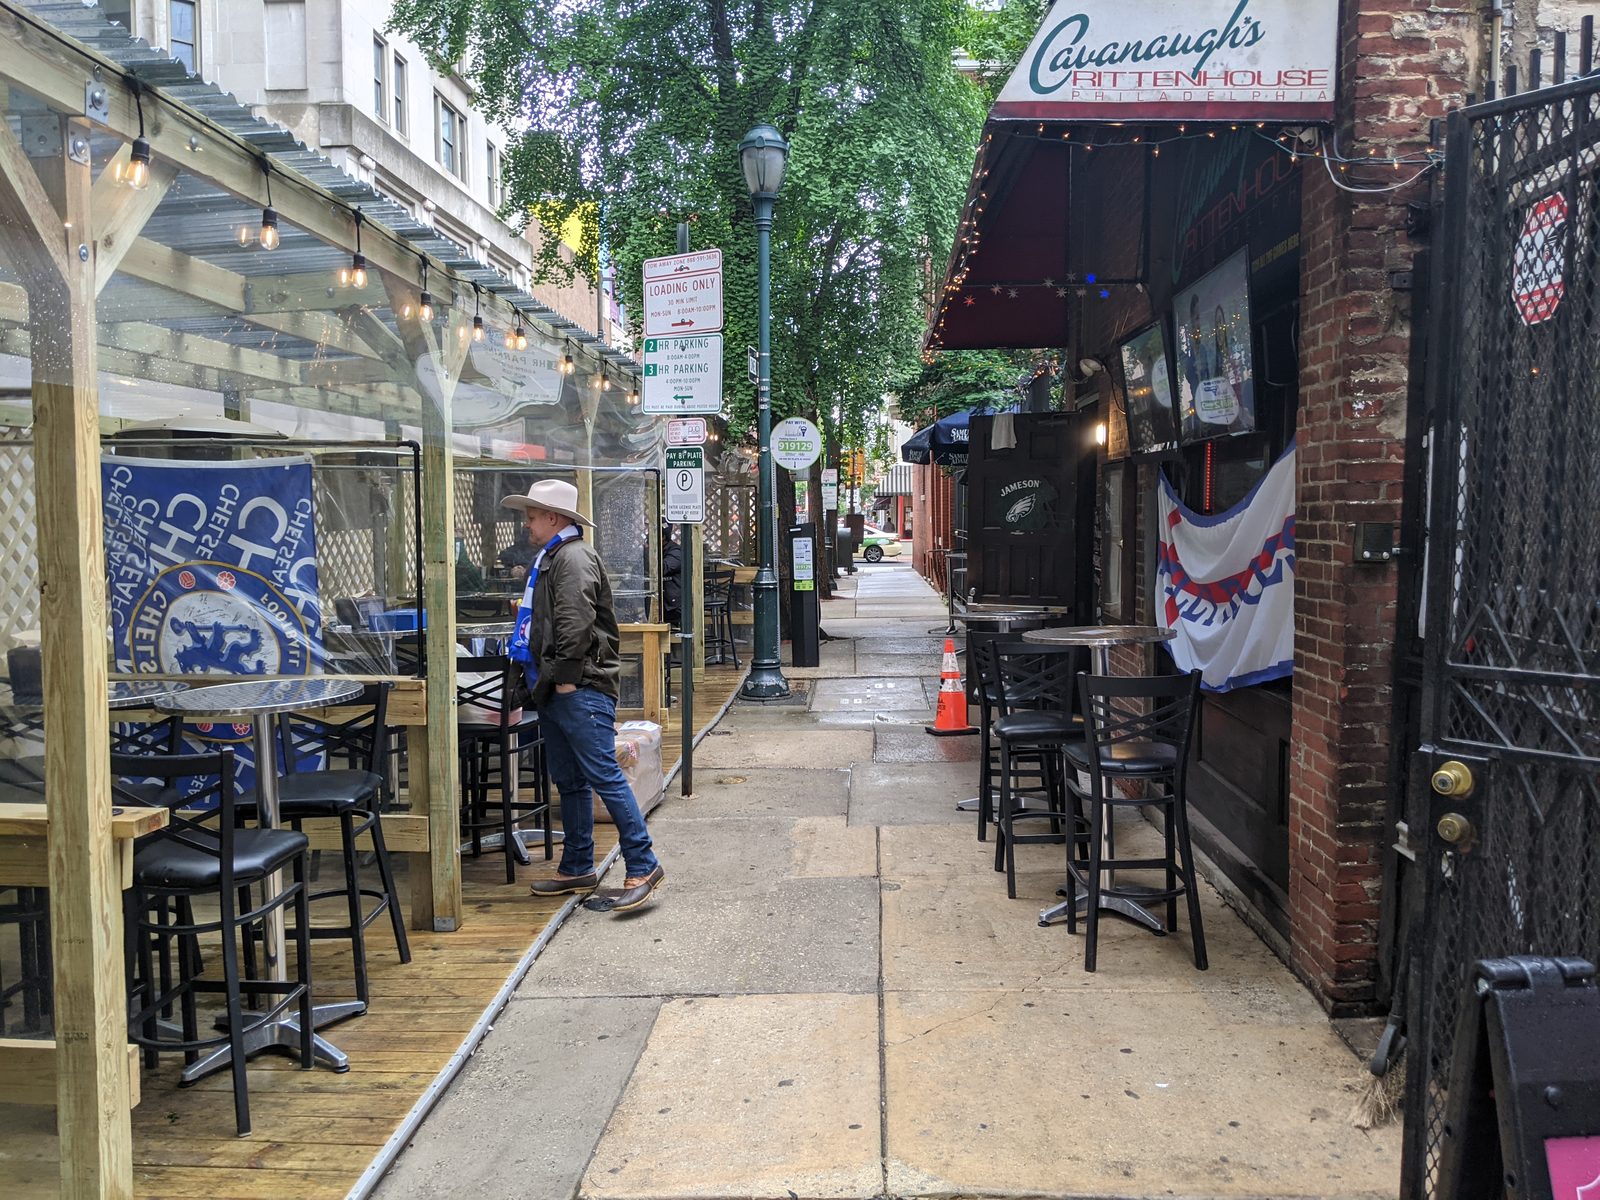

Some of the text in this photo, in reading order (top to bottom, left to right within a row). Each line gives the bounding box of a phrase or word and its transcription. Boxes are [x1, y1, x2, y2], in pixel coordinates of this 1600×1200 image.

[1028, 0, 1266, 95] Cavanaugh's
[1072, 69, 1329, 88] RITTENHOUSE
[1071, 90, 1328, 102] PHILADELPHIA
[649, 277, 715, 297] LOADING ONLY
[650, 310, 672, 318] MON-SUN
[649, 338, 709, 351] 2 HR PARKING
[648, 363, 709, 375] 3 HR PARKING
[950, 428, 969, 438] SAMU
[778, 442, 813, 451] 919129
[666, 452, 676, 460] PAY
[673, 460, 696, 468] PARKING
[1000, 479, 1040, 497] JAMESON
